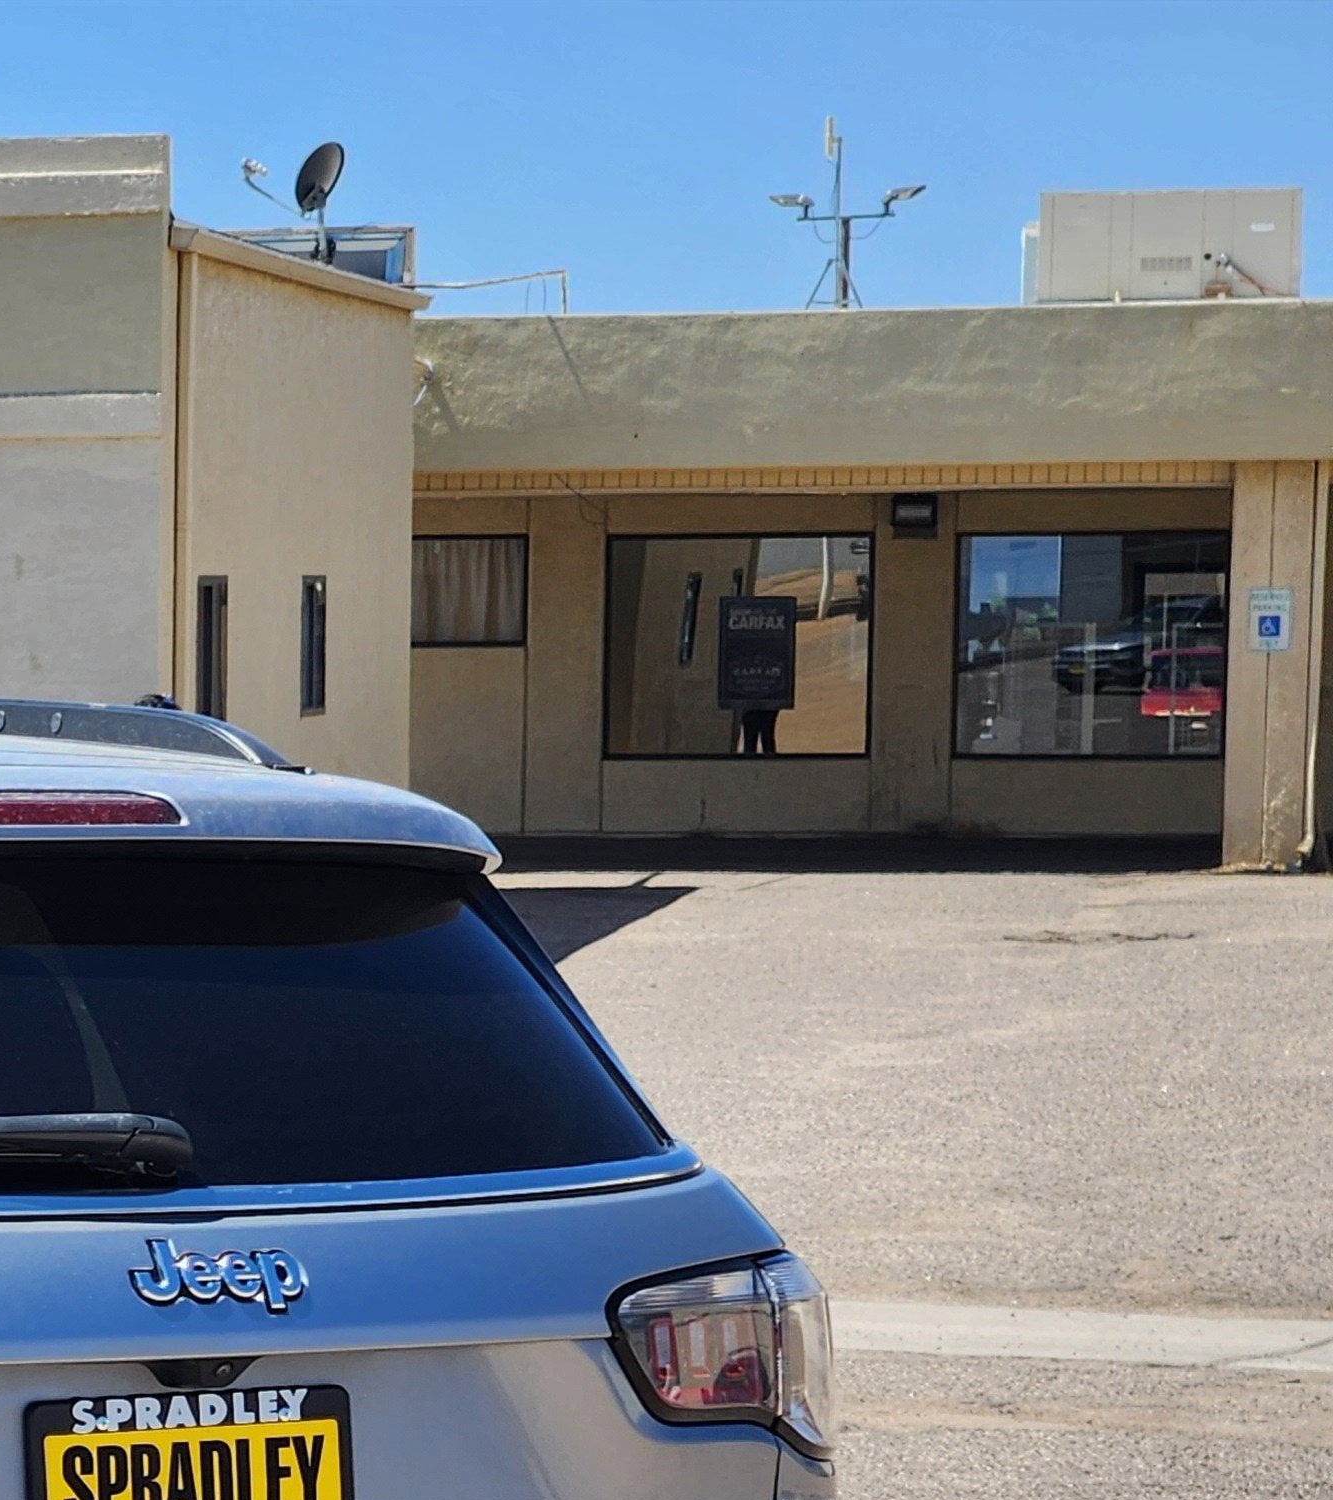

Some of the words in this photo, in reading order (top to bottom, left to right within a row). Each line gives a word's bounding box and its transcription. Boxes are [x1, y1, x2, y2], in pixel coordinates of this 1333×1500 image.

[729, 614, 785, 631] CARFAX
[128, 1236, 309, 1316] Jeep
[71, 1387, 308, 1434] SPRADLEY
